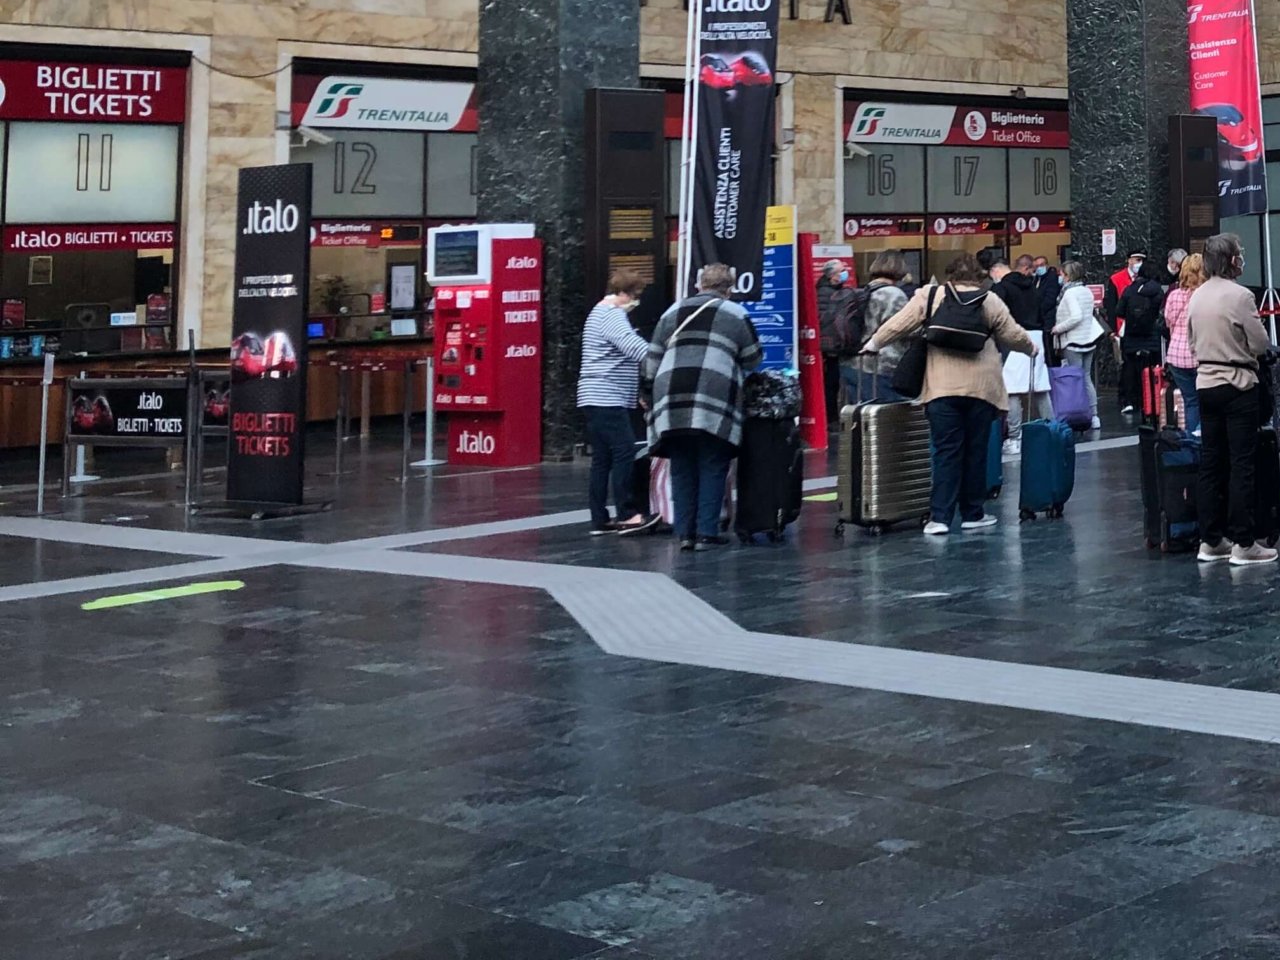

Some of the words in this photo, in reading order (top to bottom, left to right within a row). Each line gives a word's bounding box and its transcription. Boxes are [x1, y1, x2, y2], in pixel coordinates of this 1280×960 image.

[1201, 9, 1249, 22] TRENITALIA
[1190, 38, 1237, 50] Assistenza
[1191, 49, 1219, 59] Clienti
[37, 66, 161, 91] BIGLIETTI
[1194, 70, 1229, 81] Customer
[1195, 82, 1213, 90] Care
[45, 92, 152, 116] TICKETS
[357, 108, 449, 123] TRENITALIA
[991, 111, 1045, 126] Biglietteria
[882, 127, 941, 138] TRENITALIA
[992, 130, 1014, 142] Ticket
[1016, 131, 1041, 143] Office
[717, 127, 732, 171] CLIENTI
[77, 133, 113, 191] 11
[333, 141, 377, 194] 12
[730, 149, 741, 179] CARE
[867, 154, 896, 196] 16
[954, 156, 980, 196] 17
[1033, 157, 1057, 196] 18
[714, 172, 729, 238] ASSISTENZA
[724, 181, 740, 239] CUSTOMER
[64, 232, 118, 245] BIGLIETTI
[129, 231, 173, 243] TICKETS
[320, 223, 371, 234] Biglietteria
[117, 418, 148, 433] BIGLIETTI
[154, 418, 182, 433] TICKETS
[232, 412, 297, 433] BIGLIETTI
[235, 435, 290, 456] TICKETS
